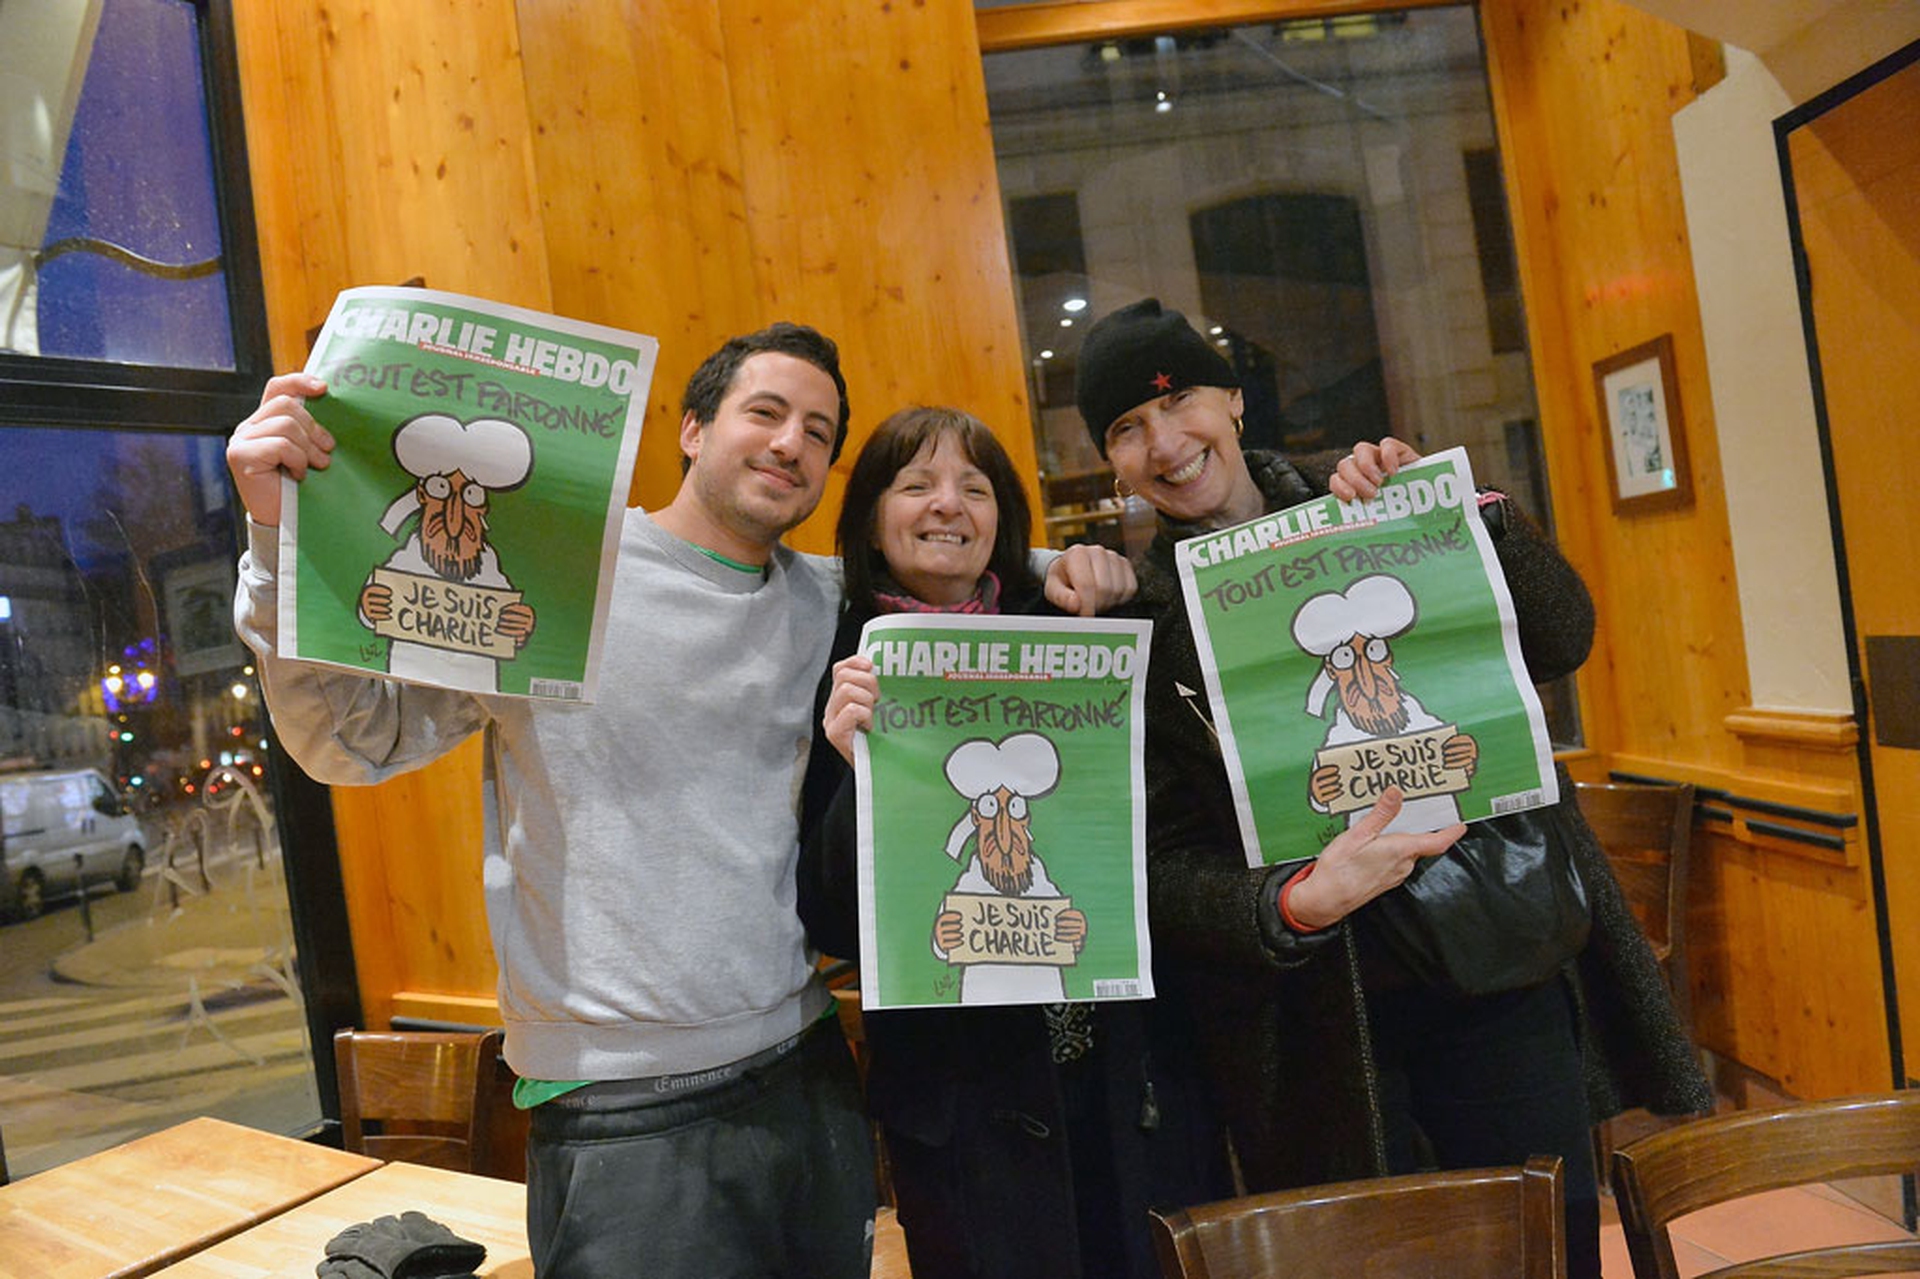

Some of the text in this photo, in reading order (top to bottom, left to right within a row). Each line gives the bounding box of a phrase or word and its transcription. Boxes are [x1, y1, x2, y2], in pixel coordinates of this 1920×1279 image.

[335, 307, 638, 396] CHARLIE HEBDO
[323, 356, 412, 391] TOUT
[410, 369, 475, 400] EST
[1189, 473, 1464, 568] CHARLIE HEBDO
[403, 582, 439, 608] JE
[1203, 564, 1276, 612] TOUT
[1280, 547, 1331, 588] EST
[866, 641, 1136, 679] CHARLIE HEBDO
[875, 696, 942, 733] TOUT
[946, 693, 997, 727] EST
[1350, 750, 1385, 772] JE
[972, 902, 1003, 925] JE
[654, 1067, 732, 1094] Eminence
